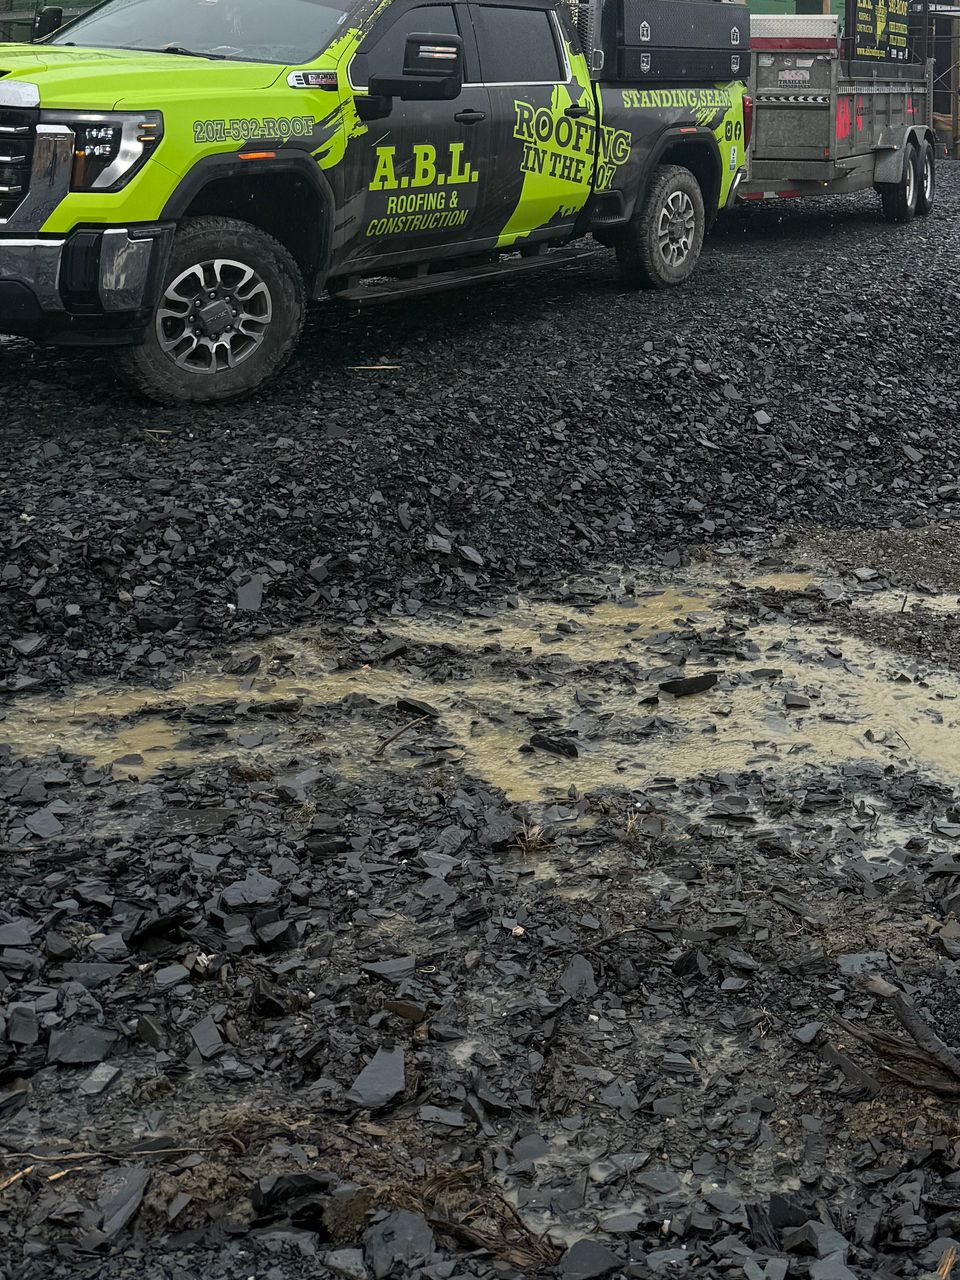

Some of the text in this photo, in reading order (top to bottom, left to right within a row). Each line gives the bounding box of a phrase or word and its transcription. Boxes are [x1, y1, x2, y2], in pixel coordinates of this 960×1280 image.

[622, 89, 698, 109] STANDING
[193, 116, 316, 143] 207-592-ROOF
[513, 100, 632, 165] ROOFING
[368, 142, 479, 191] A.B.L.
[520, 142, 548, 175] IN
[549, 151, 586, 185] THE
[387, 190, 459, 215] ROOFING &
[366, 209, 469, 237] CONSTRUCTION
